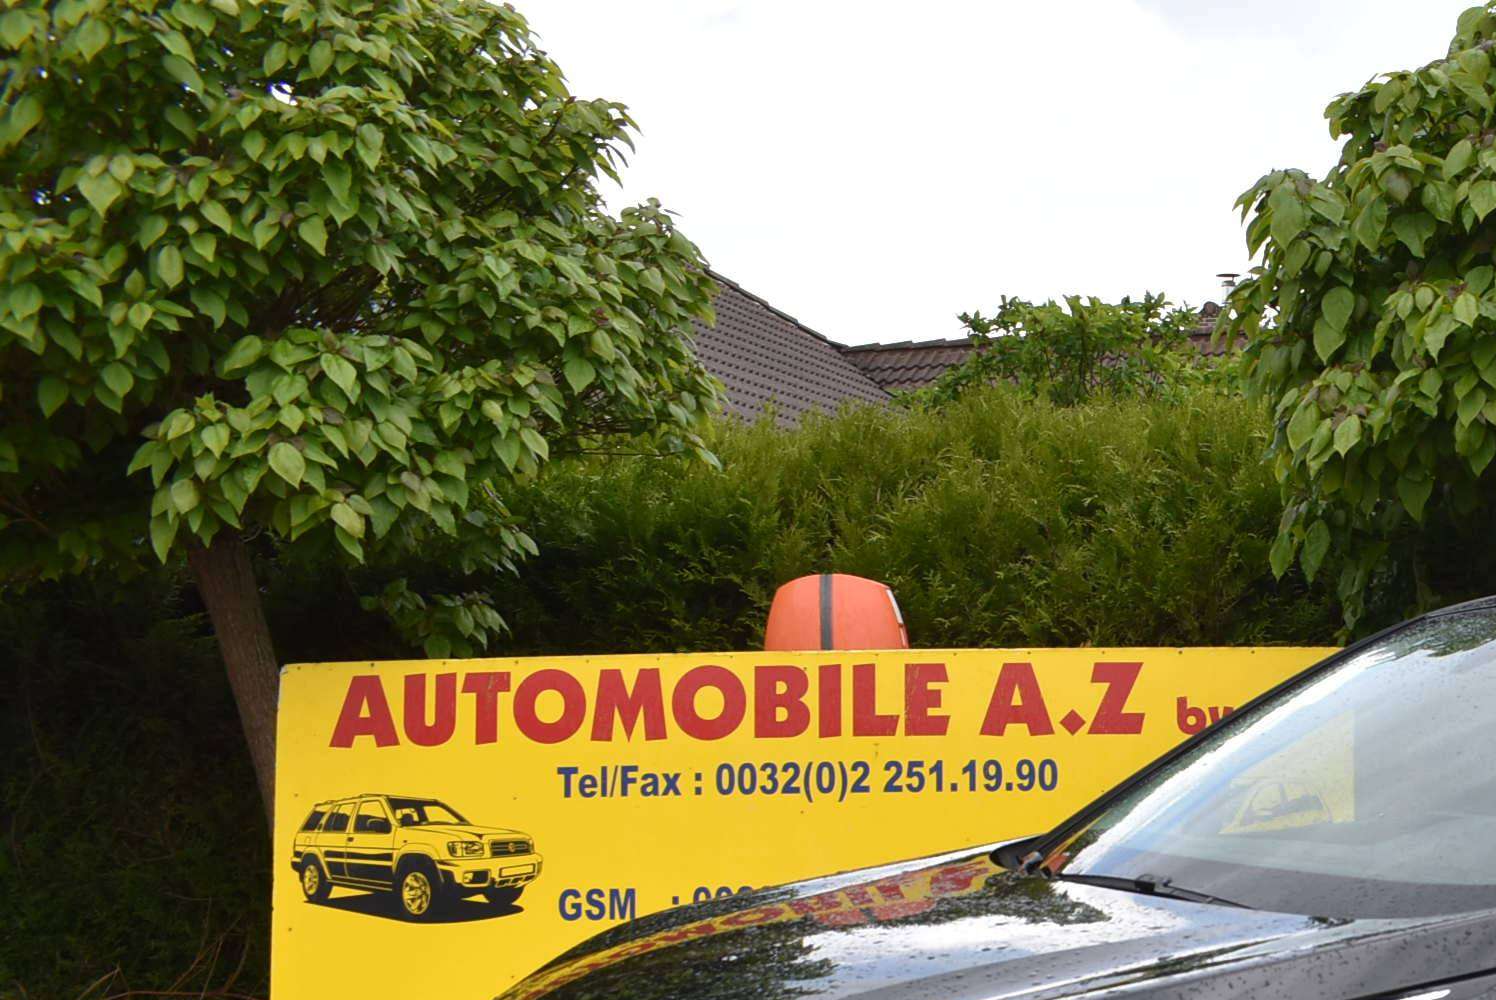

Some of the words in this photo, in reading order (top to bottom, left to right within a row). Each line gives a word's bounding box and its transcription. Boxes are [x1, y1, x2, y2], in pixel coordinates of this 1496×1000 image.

[329, 663, 950, 749] AUTOMOBILE
[979, 662, 1145, 738] A.Z
[557, 765, 682, 798] Tel/Fax
[694, 772, 702, 796] :
[715, 760, 870, 803] 0032(0)2
[883, 758, 1058, 793] 251.19.90
[558, 887, 636, 922] GSM
